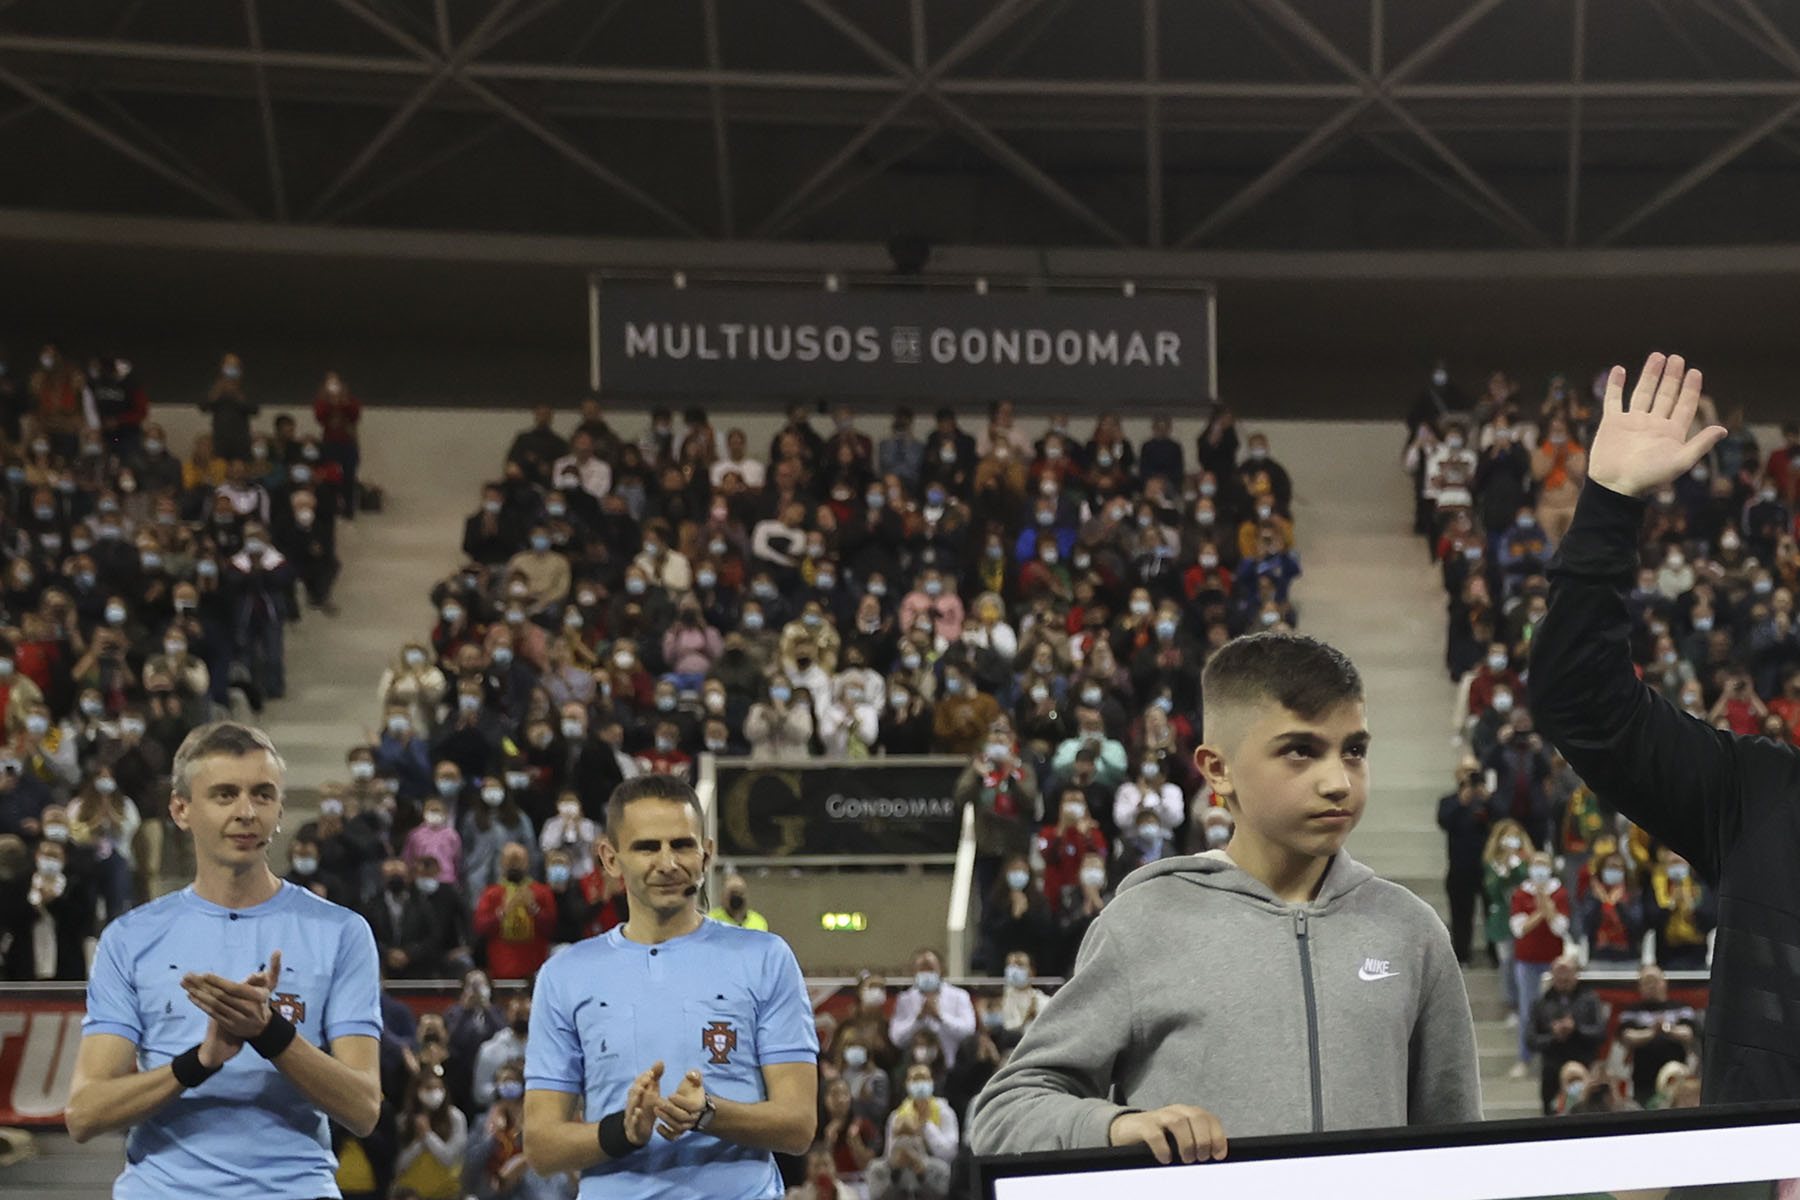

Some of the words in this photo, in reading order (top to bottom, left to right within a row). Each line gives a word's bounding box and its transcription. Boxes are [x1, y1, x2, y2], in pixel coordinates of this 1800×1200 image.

[624, 321, 881, 362] MULTIUSOS
[930, 328, 1182, 366] GONDOMAR
[1364, 958, 1390, 974] NIKE
